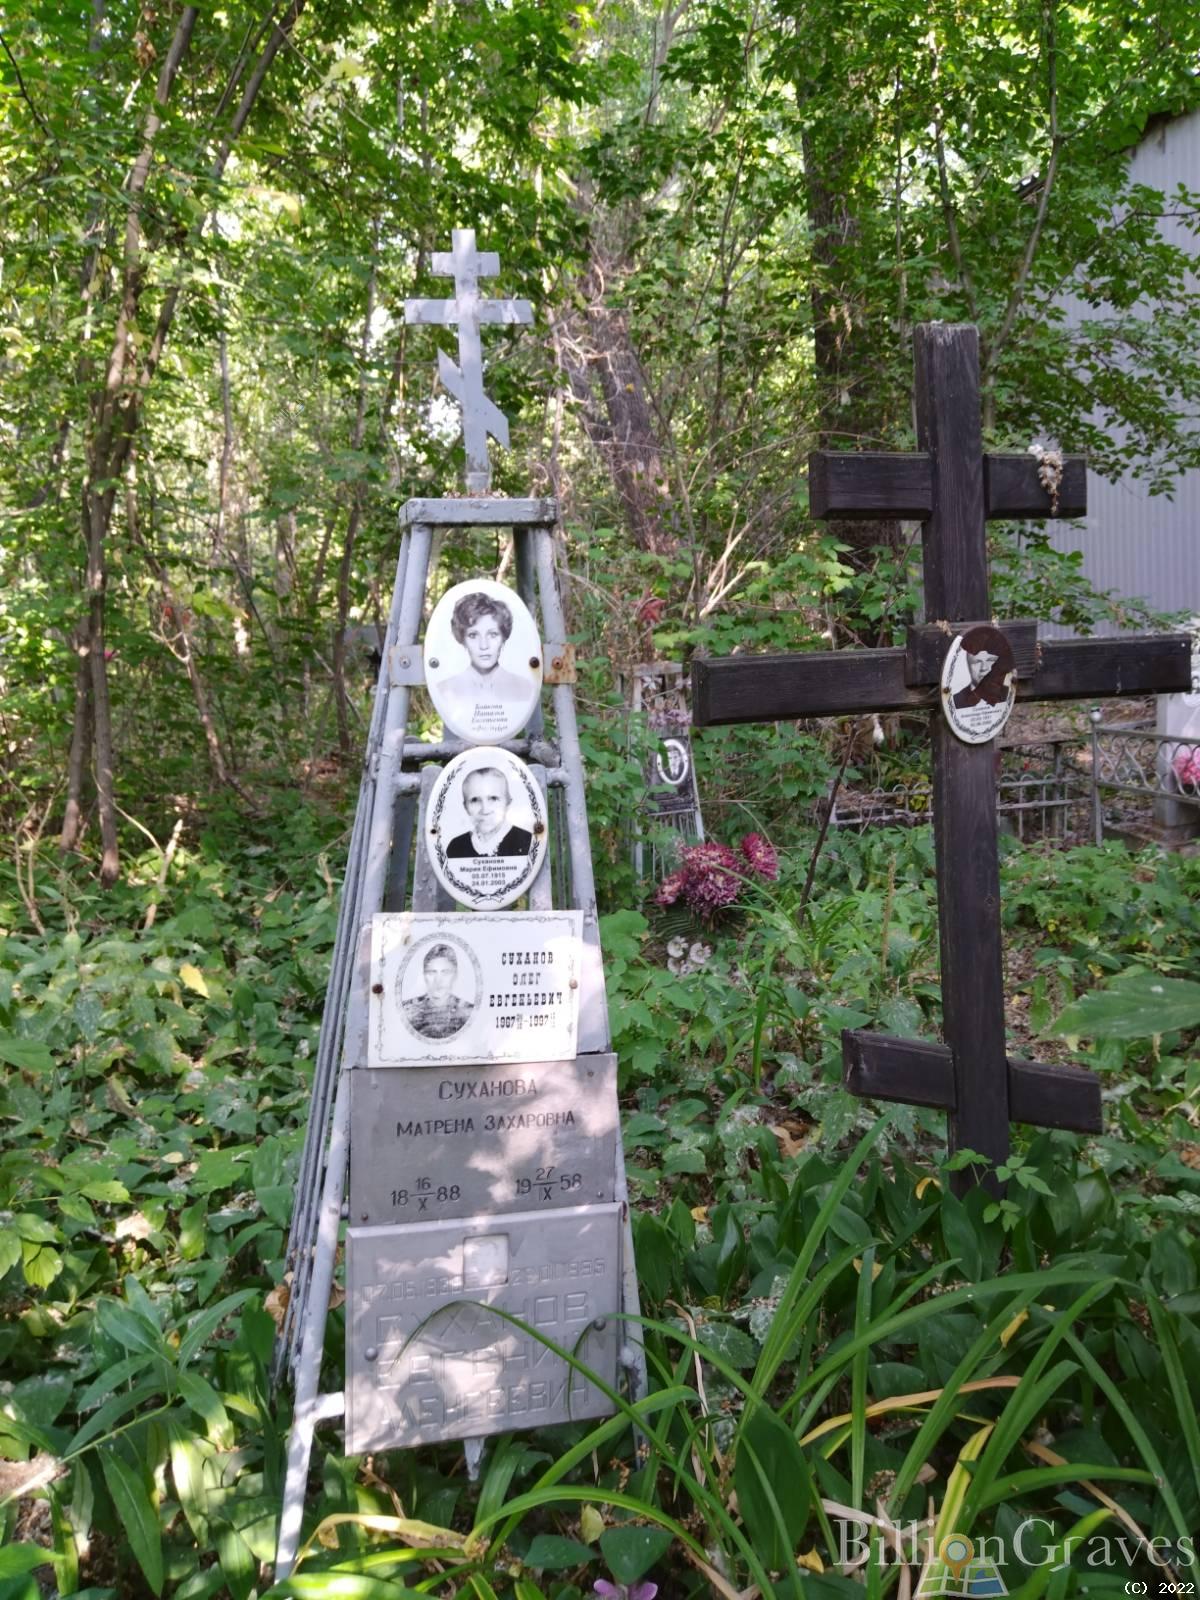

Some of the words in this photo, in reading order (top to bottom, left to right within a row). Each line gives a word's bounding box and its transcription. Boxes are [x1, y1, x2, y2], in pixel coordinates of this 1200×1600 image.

[501, 951, 554, 966] СУХАНОВ
[512, 972, 542, 987] ОЛЕГ
[489, 991, 564, 1008] ЕВГЕНЬЕВИЧ
[438, 1079, 537, 1100] СУХАНОВА
[396, 1117, 475, 1137] МАТРЕНА
[484, 1110, 576, 1131] ЗАХАРОВНА
